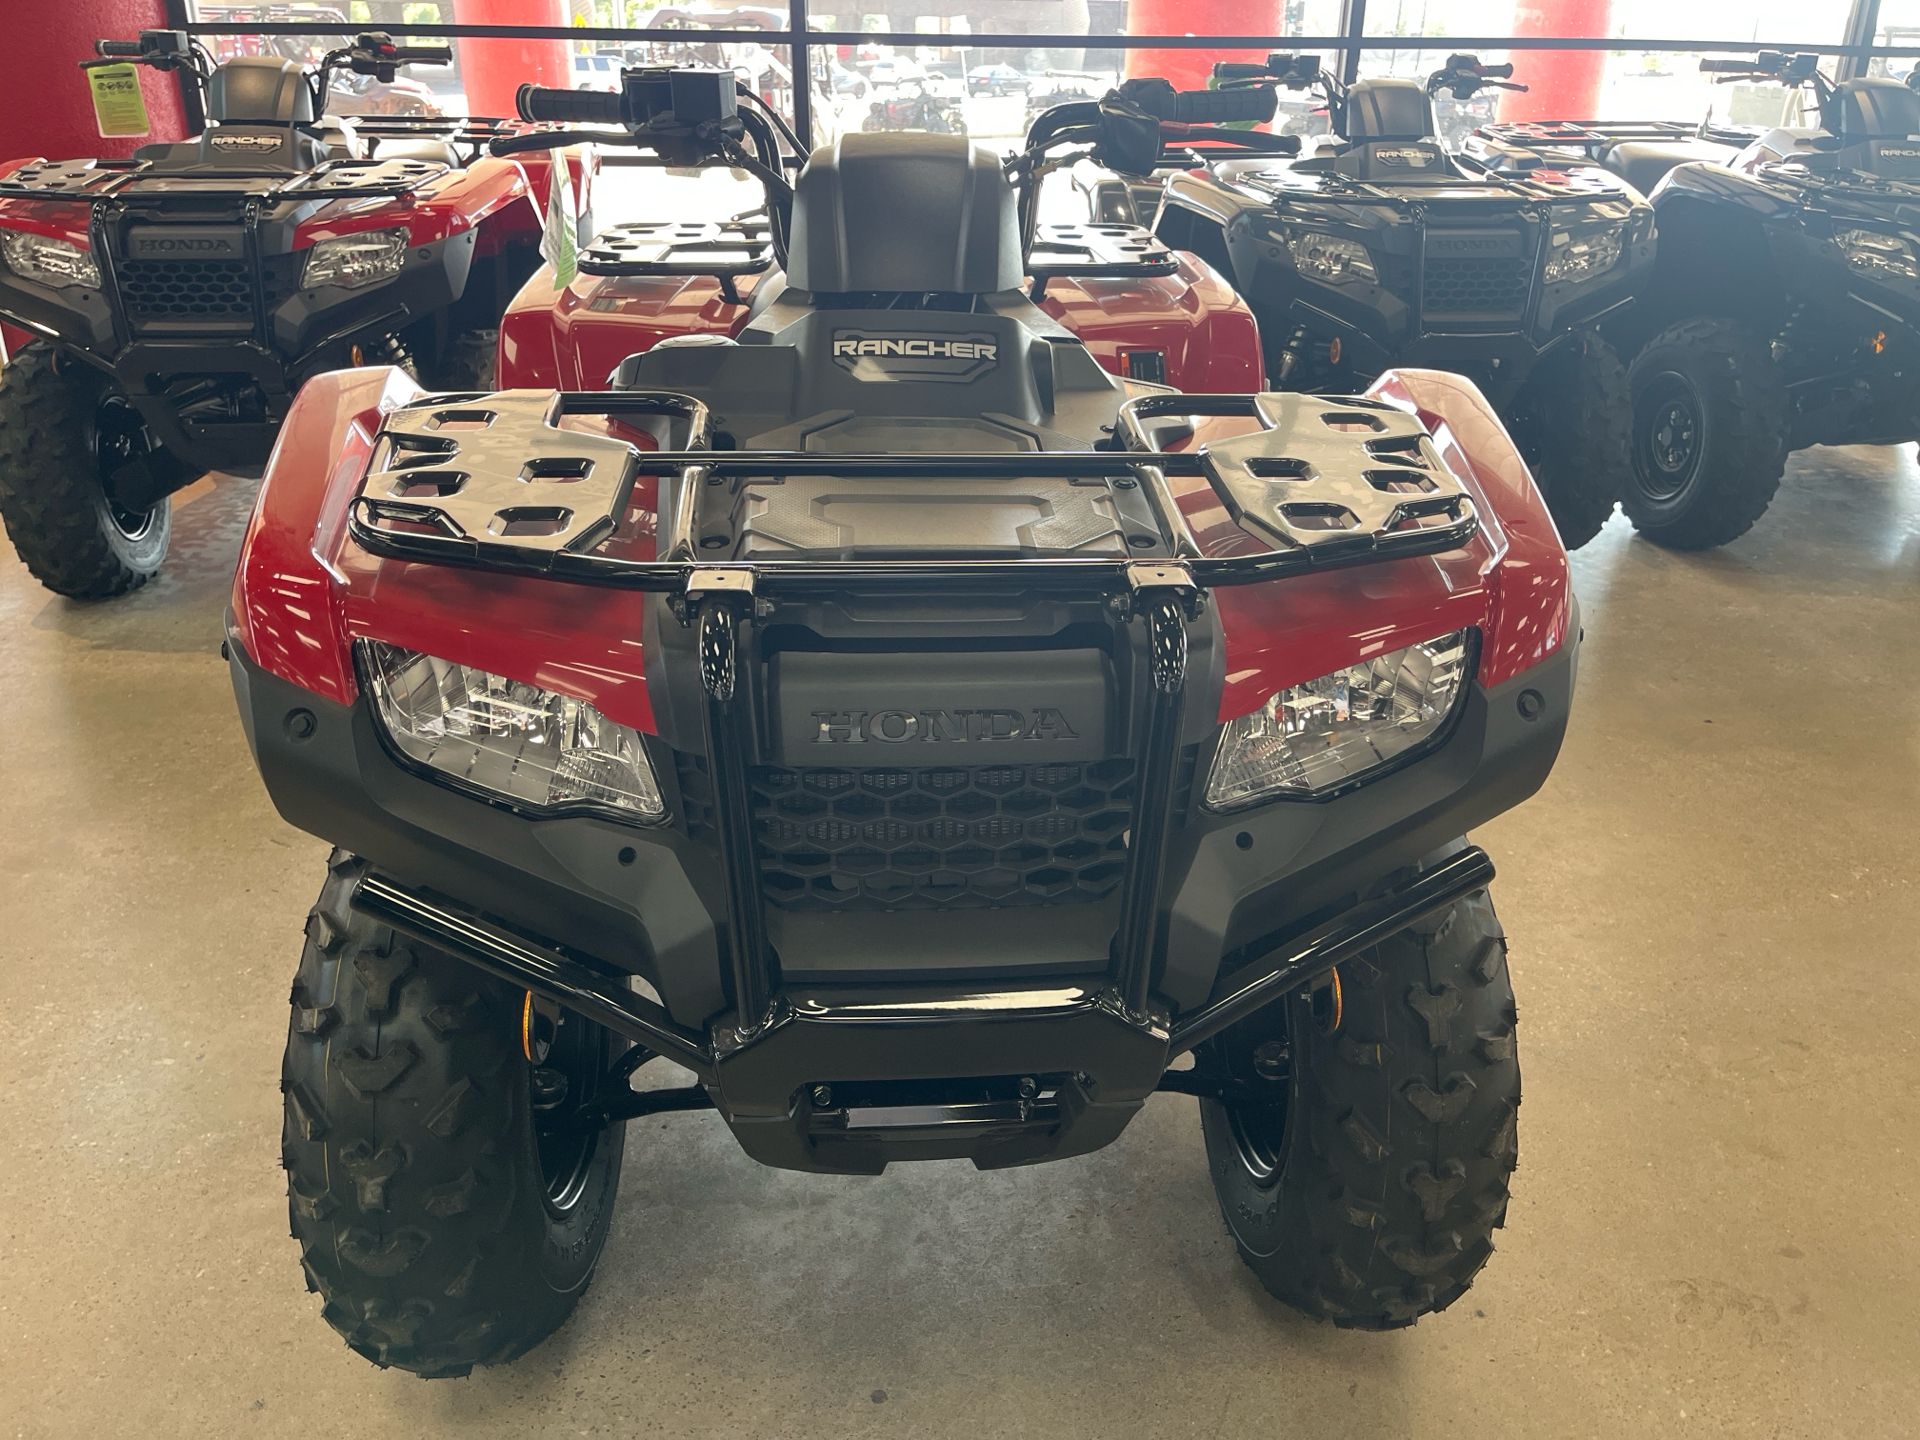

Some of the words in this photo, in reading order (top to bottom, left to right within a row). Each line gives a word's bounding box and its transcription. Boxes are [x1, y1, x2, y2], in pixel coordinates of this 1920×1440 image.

[211, 136, 283, 146] RANCHER
[1376, 150, 1435, 159] RANCHER
[138, 239, 234, 252] HONDA
[833, 339, 997, 361] RANCHER
[811, 708, 1080, 744] HONDA
